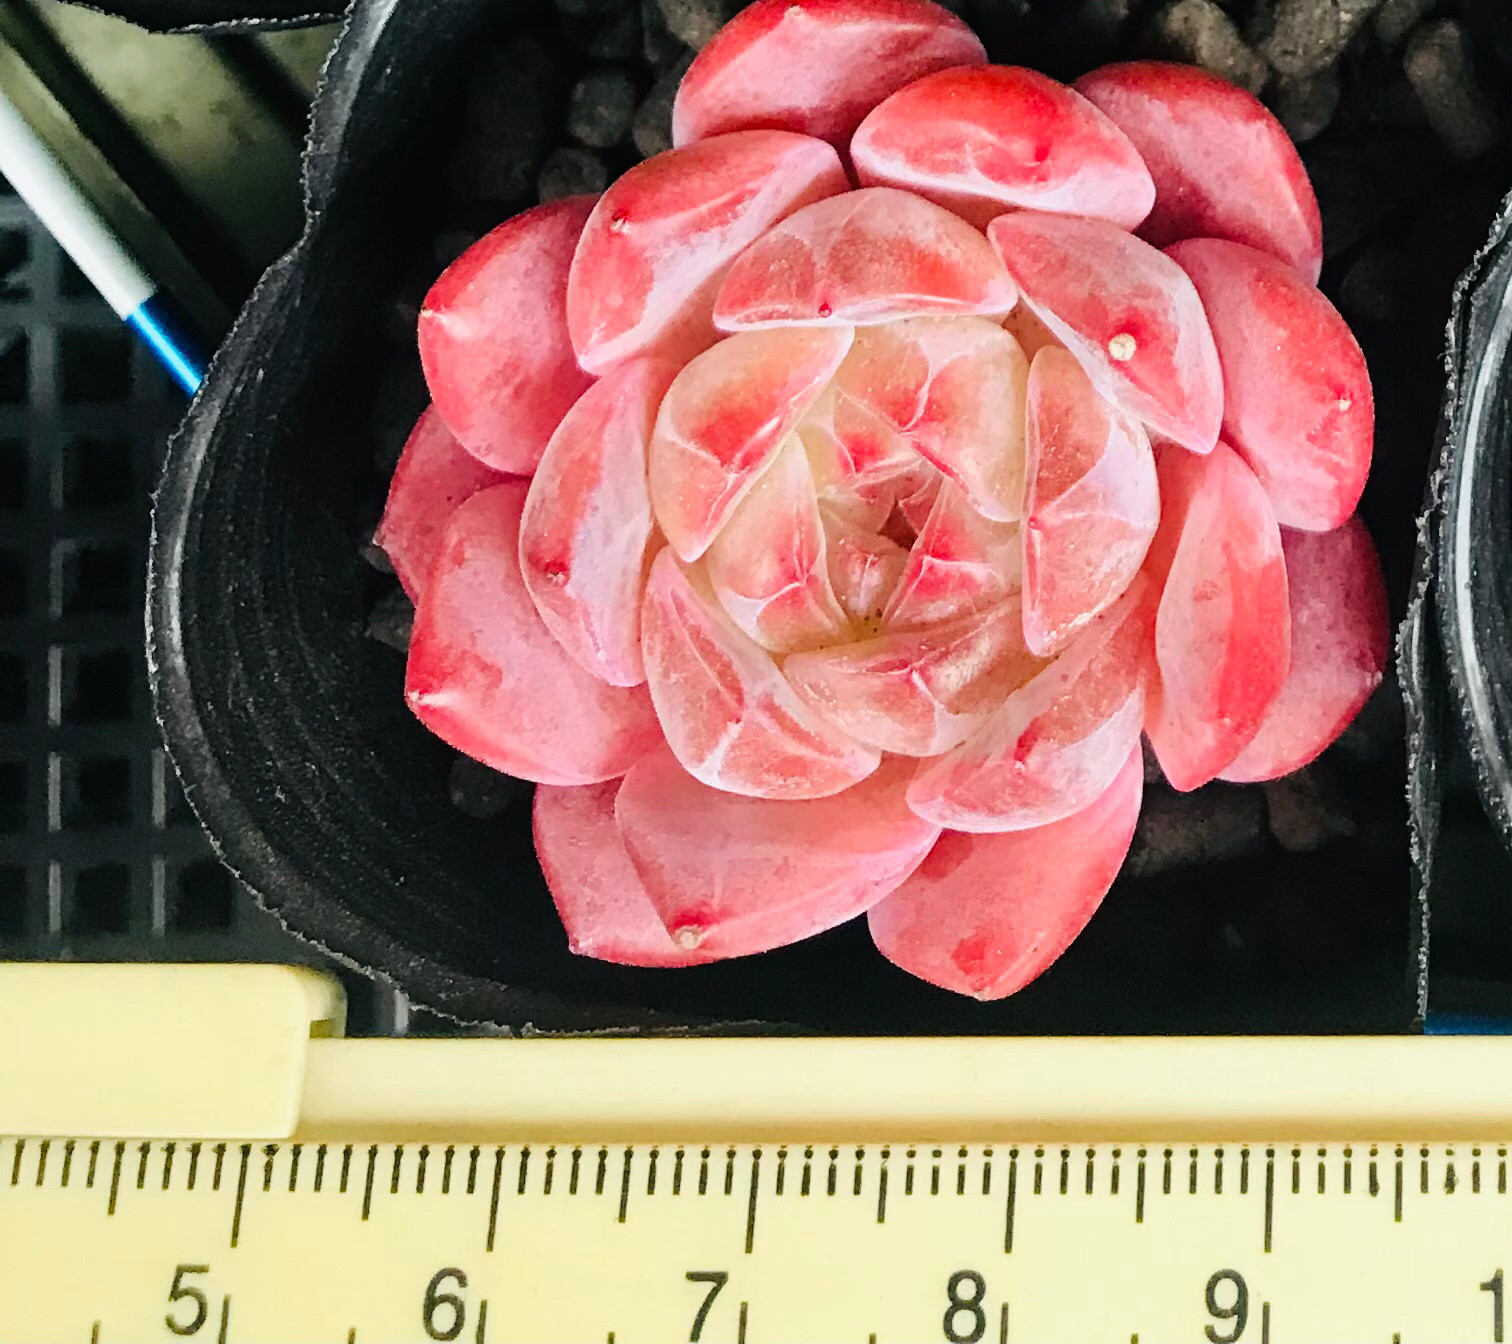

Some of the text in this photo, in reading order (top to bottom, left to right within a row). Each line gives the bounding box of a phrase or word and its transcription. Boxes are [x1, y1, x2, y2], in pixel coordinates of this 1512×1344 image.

[166, 1265, 209, 1336] 5
[422, 1267, 468, 1342] 6
[685, 1271, 729, 1343] 7
[942, 1269, 987, 1344] 8
[1204, 1269, 1249, 1344] 9
